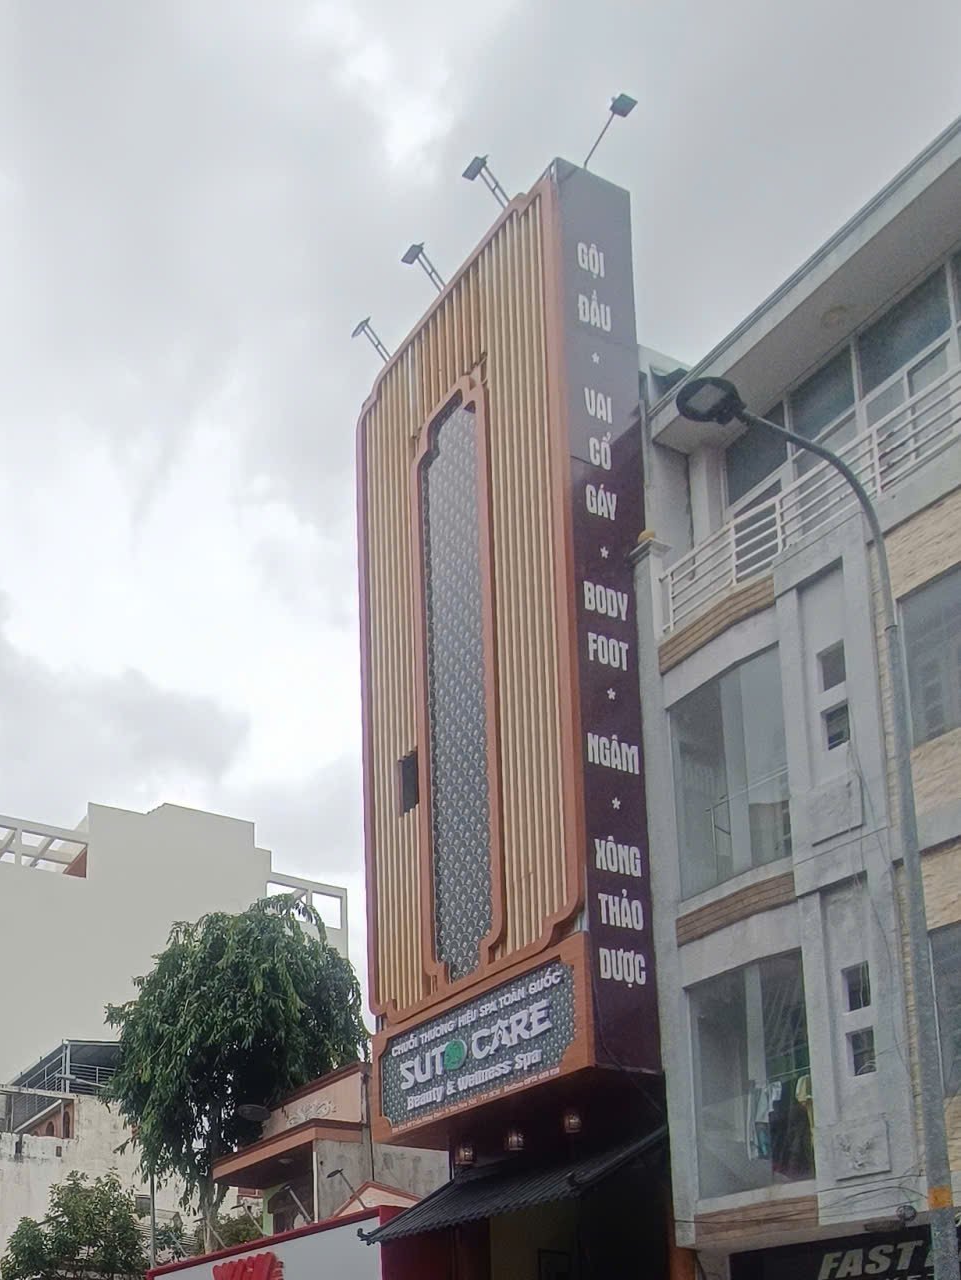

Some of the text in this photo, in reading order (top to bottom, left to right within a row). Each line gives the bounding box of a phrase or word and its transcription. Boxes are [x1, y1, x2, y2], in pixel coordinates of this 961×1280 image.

[577, 242, 605, 278] GỘI
[578, 290, 611, 332] ĐẦU
[584, 387, 613, 424] VAI
[589, 433, 612, 471] CỔ
[586, 484, 617, 521] GÁY
[583, 580, 628, 621] BODY
[587, 632, 629, 671] FOOT
[587, 732, 639, 775] NGÂM
[594, 836, 642, 877] XÔNG
[598, 888, 643, 931] THẢO
[599, 948, 646, 988] DƯỢC
[471, 999, 552, 1060] CARE
[479, 1002, 498, 1018] SPA
[407, 1085, 444, 1110] Beauty
[447, 1080, 457, 1095] &
[817, 1240, 924, 1280] FAST
